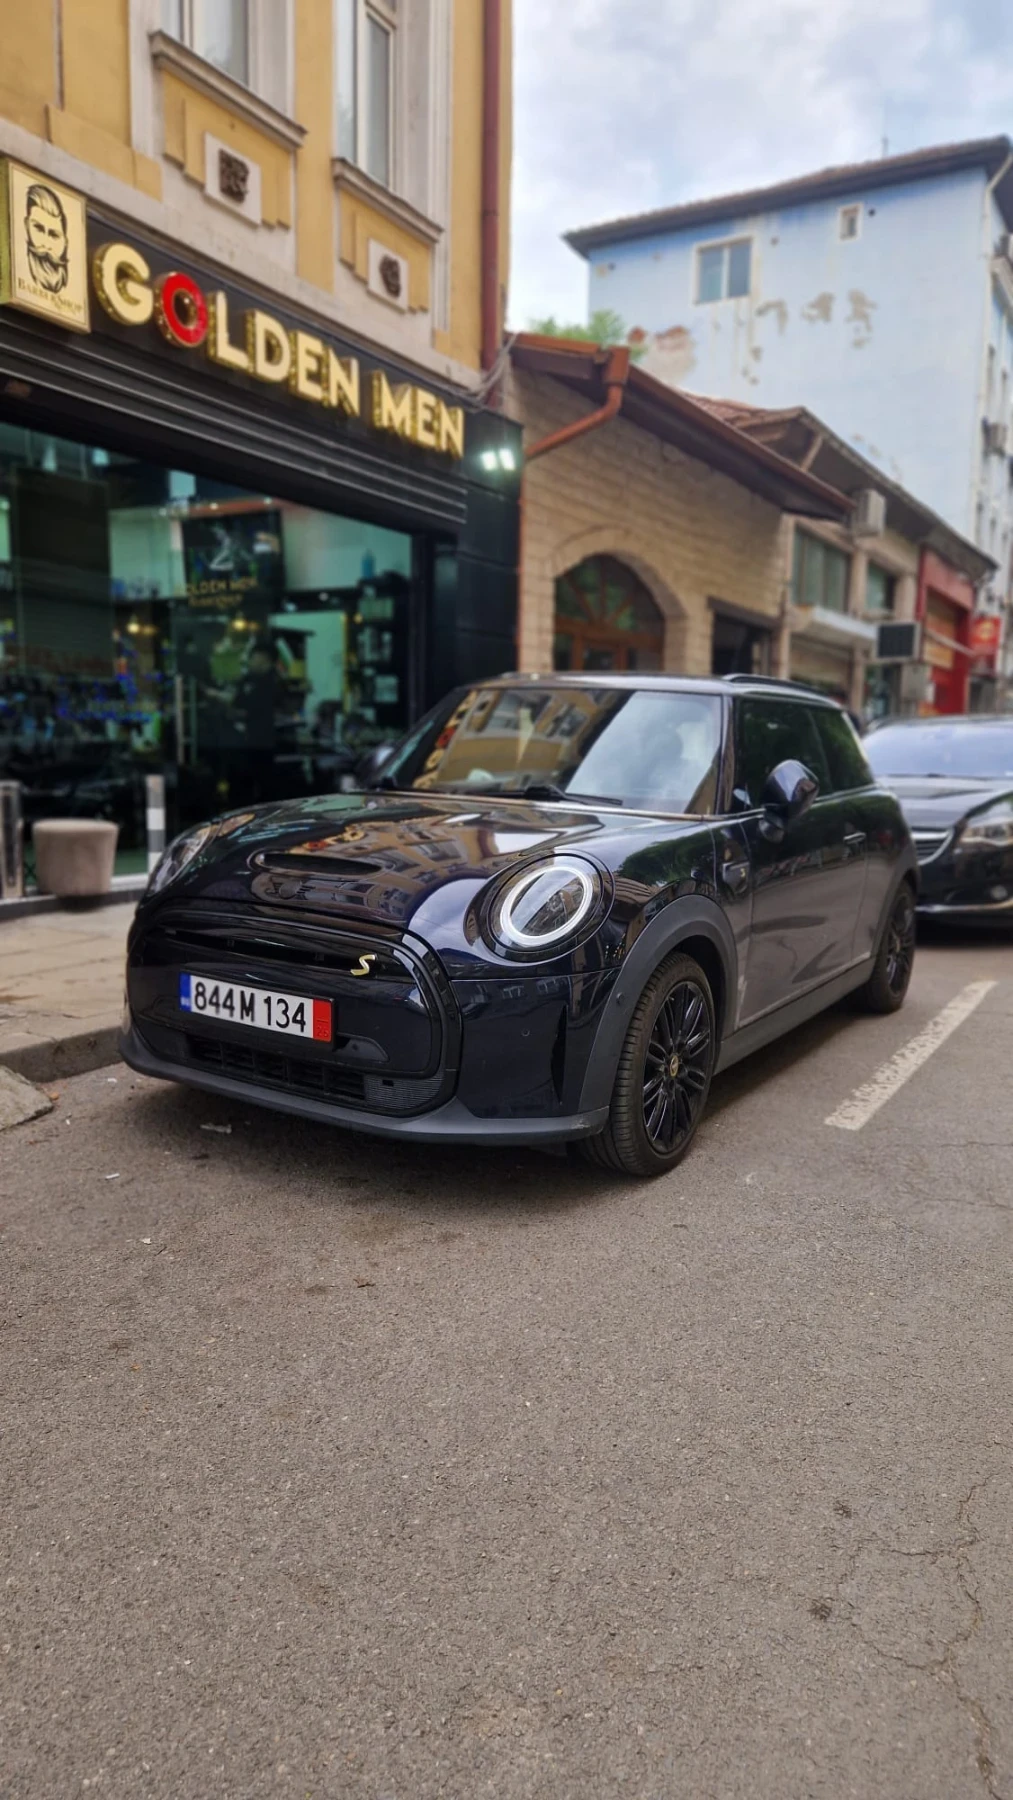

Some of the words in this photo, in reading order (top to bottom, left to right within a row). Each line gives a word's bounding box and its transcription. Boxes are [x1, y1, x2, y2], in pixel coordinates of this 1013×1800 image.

[94, 242, 360, 417] GOLDEN
[371, 371, 464, 459] MEN
[350, 954, 376, 976] S
[194, 981, 235, 1018] 844
[240, 990, 255, 1023] M
[264, 996, 306, 1033] 134
